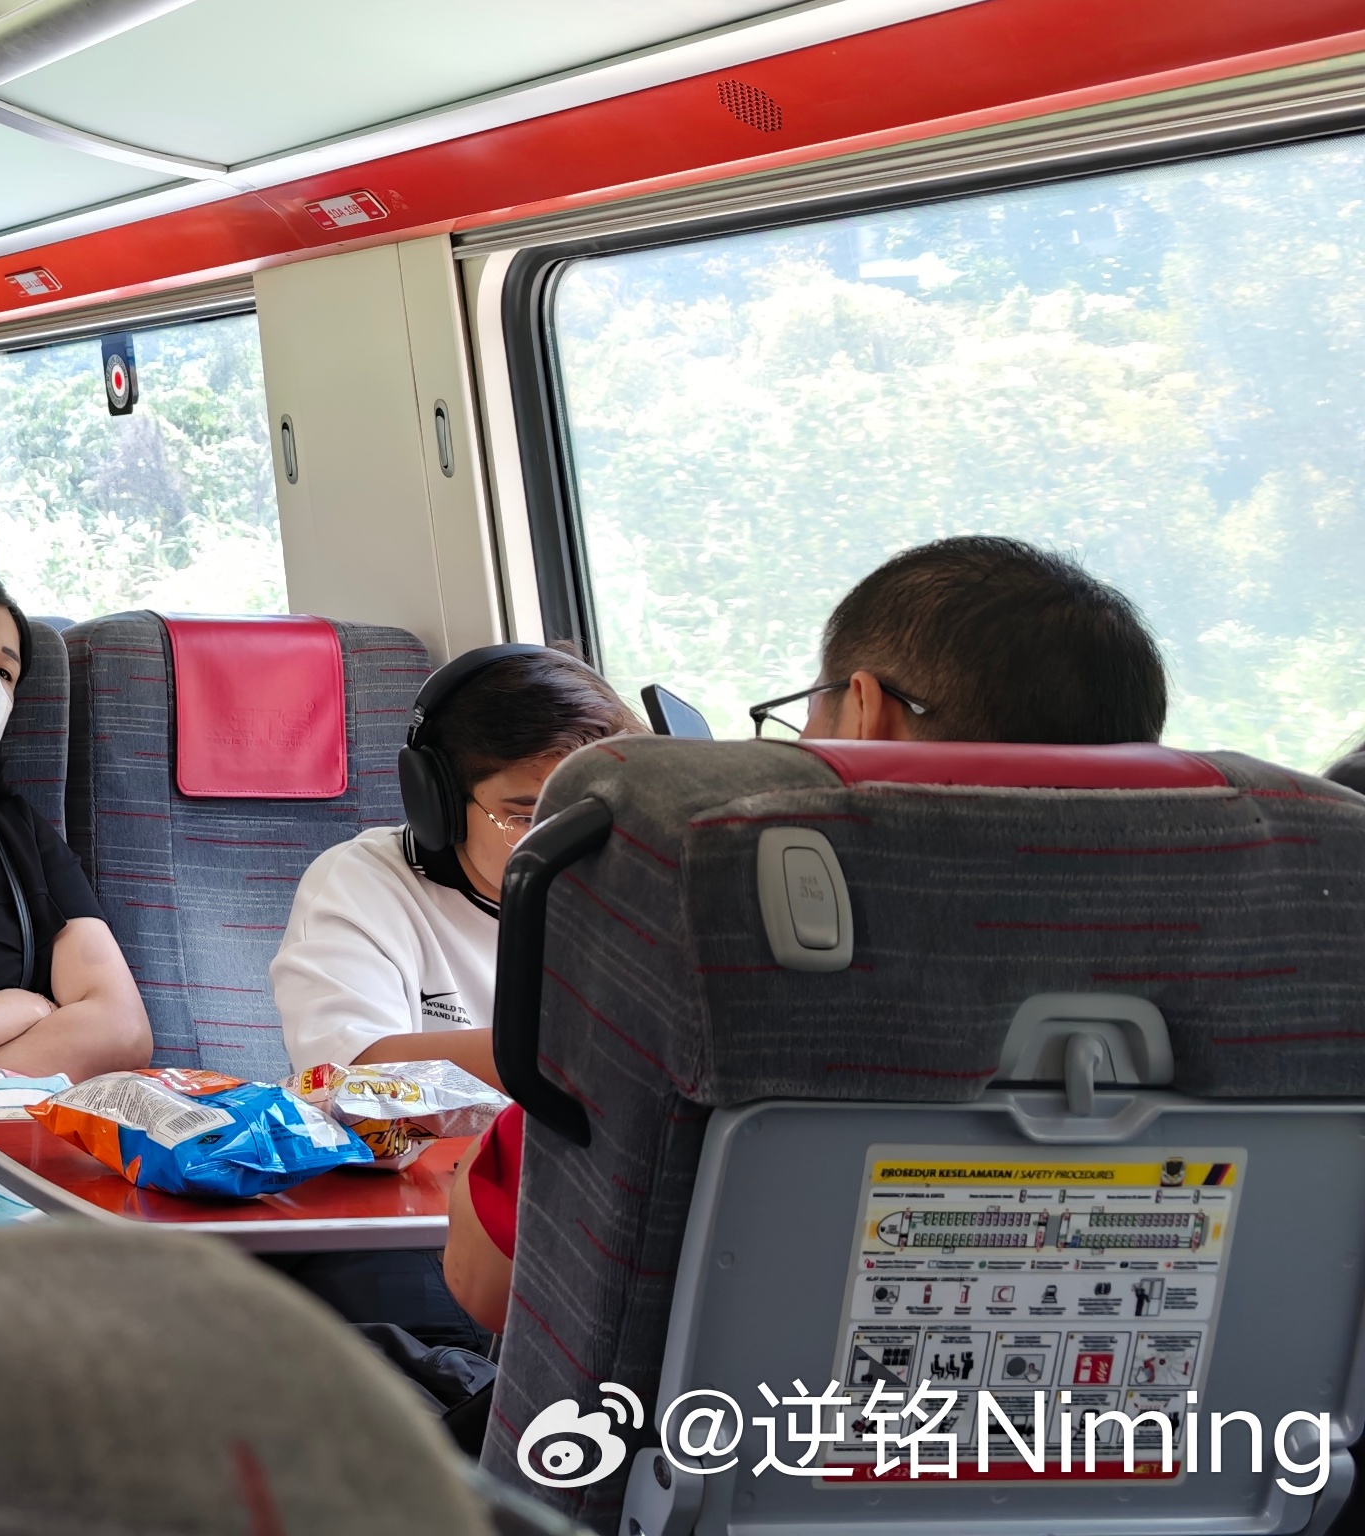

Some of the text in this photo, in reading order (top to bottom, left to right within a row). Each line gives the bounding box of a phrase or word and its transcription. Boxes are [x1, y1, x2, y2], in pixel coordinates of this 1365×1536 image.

[327, 208, 347, 219] 10A
[425, 1001, 457, 1012] WORLD
[422, 1009, 451, 1020] GRAND
[880, 1167, 936, 1178] PROSEDUR
[938, 1167, 1012, 1178] KESELAMATAN
[1020, 1169, 1054, 1179] SAFETY
[1054, 1169, 1115, 1179] PROCEDURES
